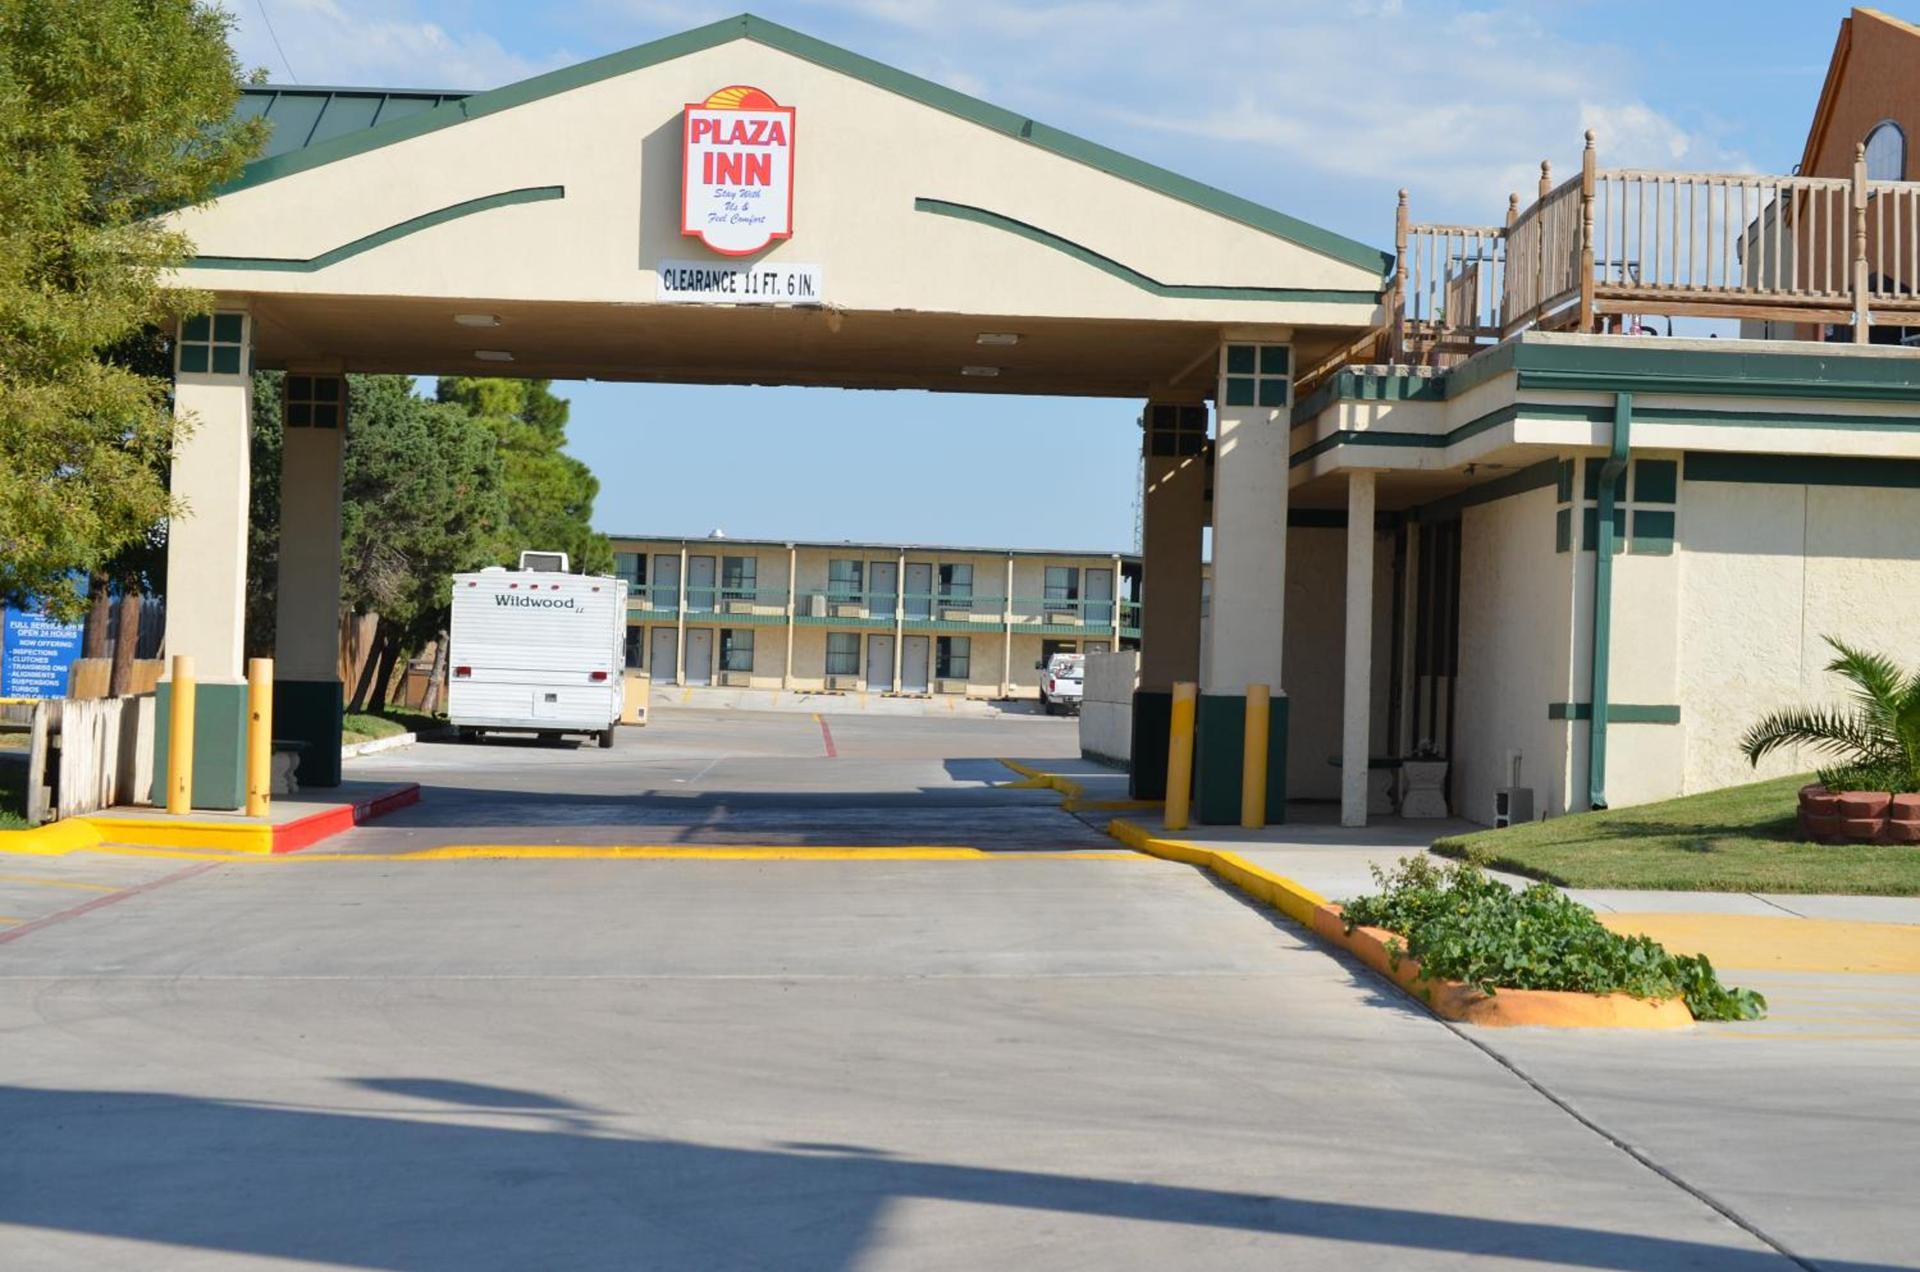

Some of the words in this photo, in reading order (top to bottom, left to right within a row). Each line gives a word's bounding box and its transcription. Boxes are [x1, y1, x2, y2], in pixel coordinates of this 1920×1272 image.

[690, 118, 787, 146] PLAZA
[703, 151, 772, 186] INN
[713, 188, 737, 201] Stay
[739, 188, 761, 199] With
[724, 201, 738, 211] Us
[707, 212, 728, 224] Feel
[729, 213, 767, 226] Comfort
[663, 268, 737, 294] CLEARANCE
[744, 272, 758, 294] 11
[762, 272, 781, 295] FT.
[787, 274, 795, 296] 6
[799, 274, 815, 297] IN.
[495, 594, 574, 609] Wildwood
[10, 621, 29, 629] FULL
[18, 629, 39, 637] OPEN
[51, 630, 77, 639] HOURS
[12, 648, 58, 656] INSPECTIONS
[11, 671, 56, 679] ALIGNMENTS
[11, 679, 60, 687] SUSPENSIONS
